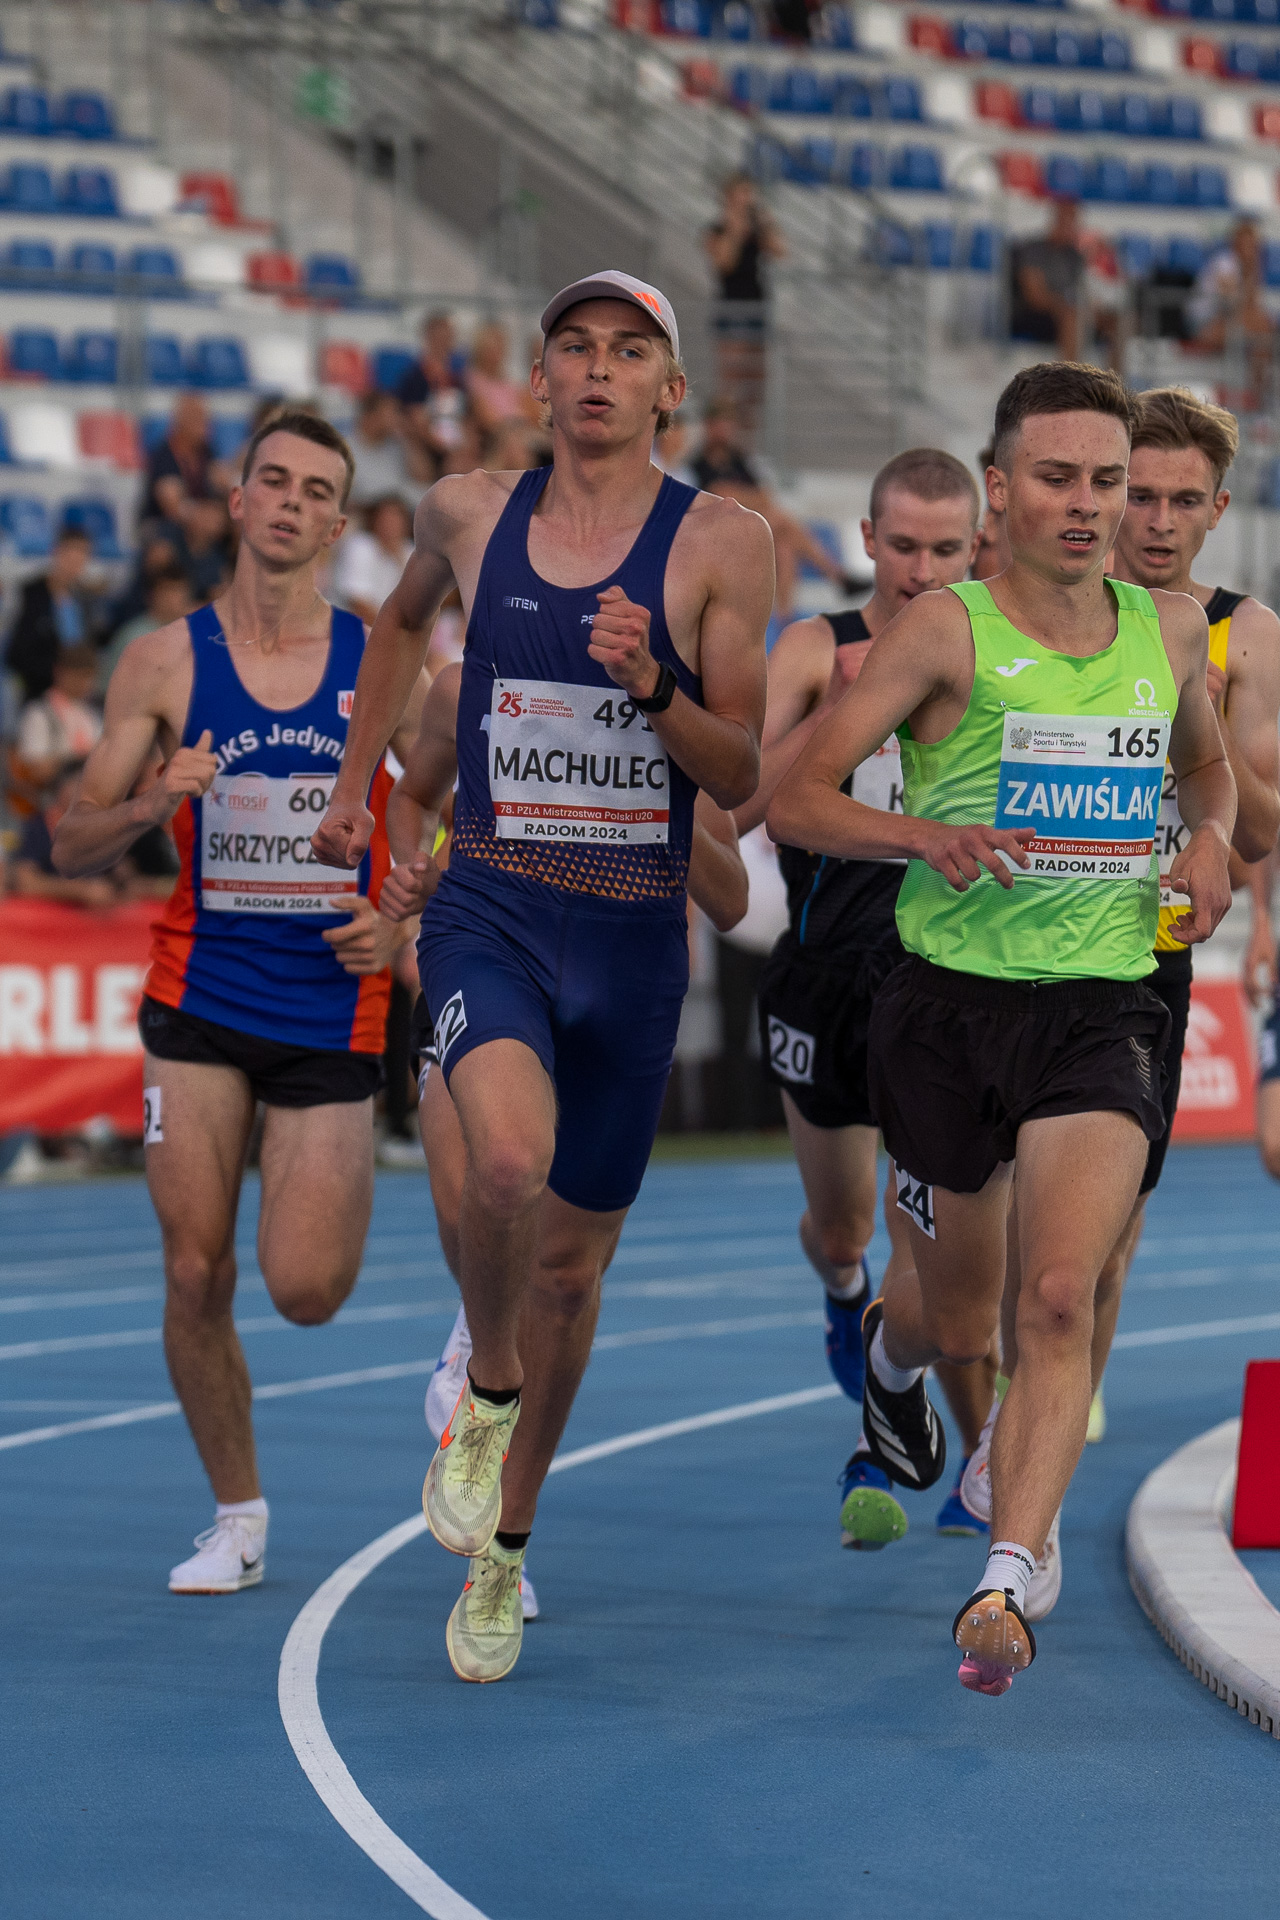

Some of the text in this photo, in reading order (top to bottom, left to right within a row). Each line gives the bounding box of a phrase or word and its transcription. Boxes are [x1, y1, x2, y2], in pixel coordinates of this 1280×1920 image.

[1034, 730, 1075, 738] Ministerstwo
[1107, 727, 1160, 758] 165
[1033, 739, 1054, 747] Sportu
[494, 746, 665, 790] MACHULEC
[1004, 778, 1158, 820] ZAWIŚLAK
[500, 804, 653, 822] 78. PZLA Mistrzostwa Polski U20
[524, 823, 628, 840] RADOM 2024
[1029, 841, 1052, 851] PZLA
[1054, 843, 1112, 853] Mistrzostwa
[1114, 845, 1135, 854] Polski
[1135, 844, 1147, 853] U20
[1035, 859, 1130, 873] RADOM 2024
[234, 896, 322, 908] RADOM 2024
[771, 1023, 809, 1075] 20
[898, 1168, 935, 1232] 24
